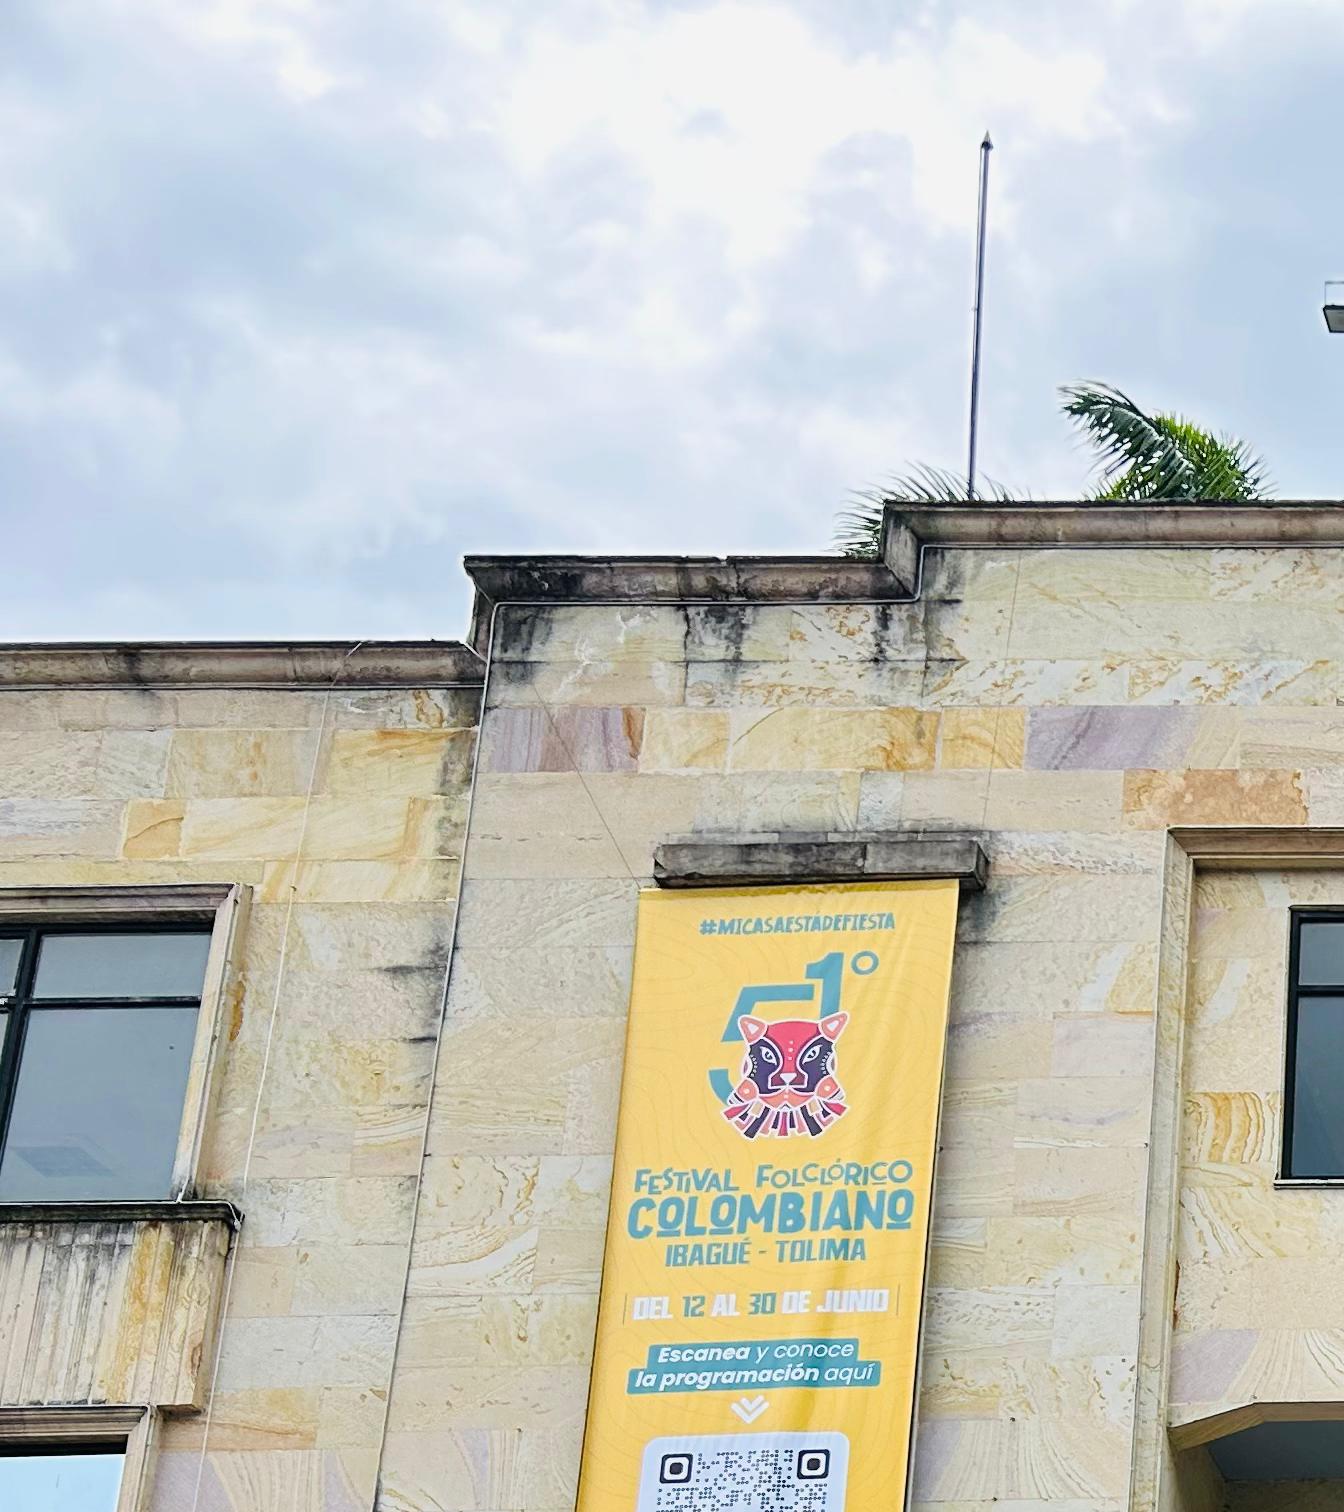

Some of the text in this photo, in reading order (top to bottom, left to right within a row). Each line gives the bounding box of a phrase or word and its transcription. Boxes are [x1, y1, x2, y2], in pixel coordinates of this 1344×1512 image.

[634, 1158, 913, 1196] FESTIVAL FOLCLÓRICO
[627, 1188, 915, 1240] COLOMBIANO
[665, 1237, 752, 1267] IBAGUÉ
[776, 1238, 866, 1264] TOLIMA
[632, 1289, 890, 1321] DEL 12 AL 30 DE JUNIO
[657, 1343, 855, 1364] Escanea y conoce
[635, 1362, 876, 1391] la programación aquí
